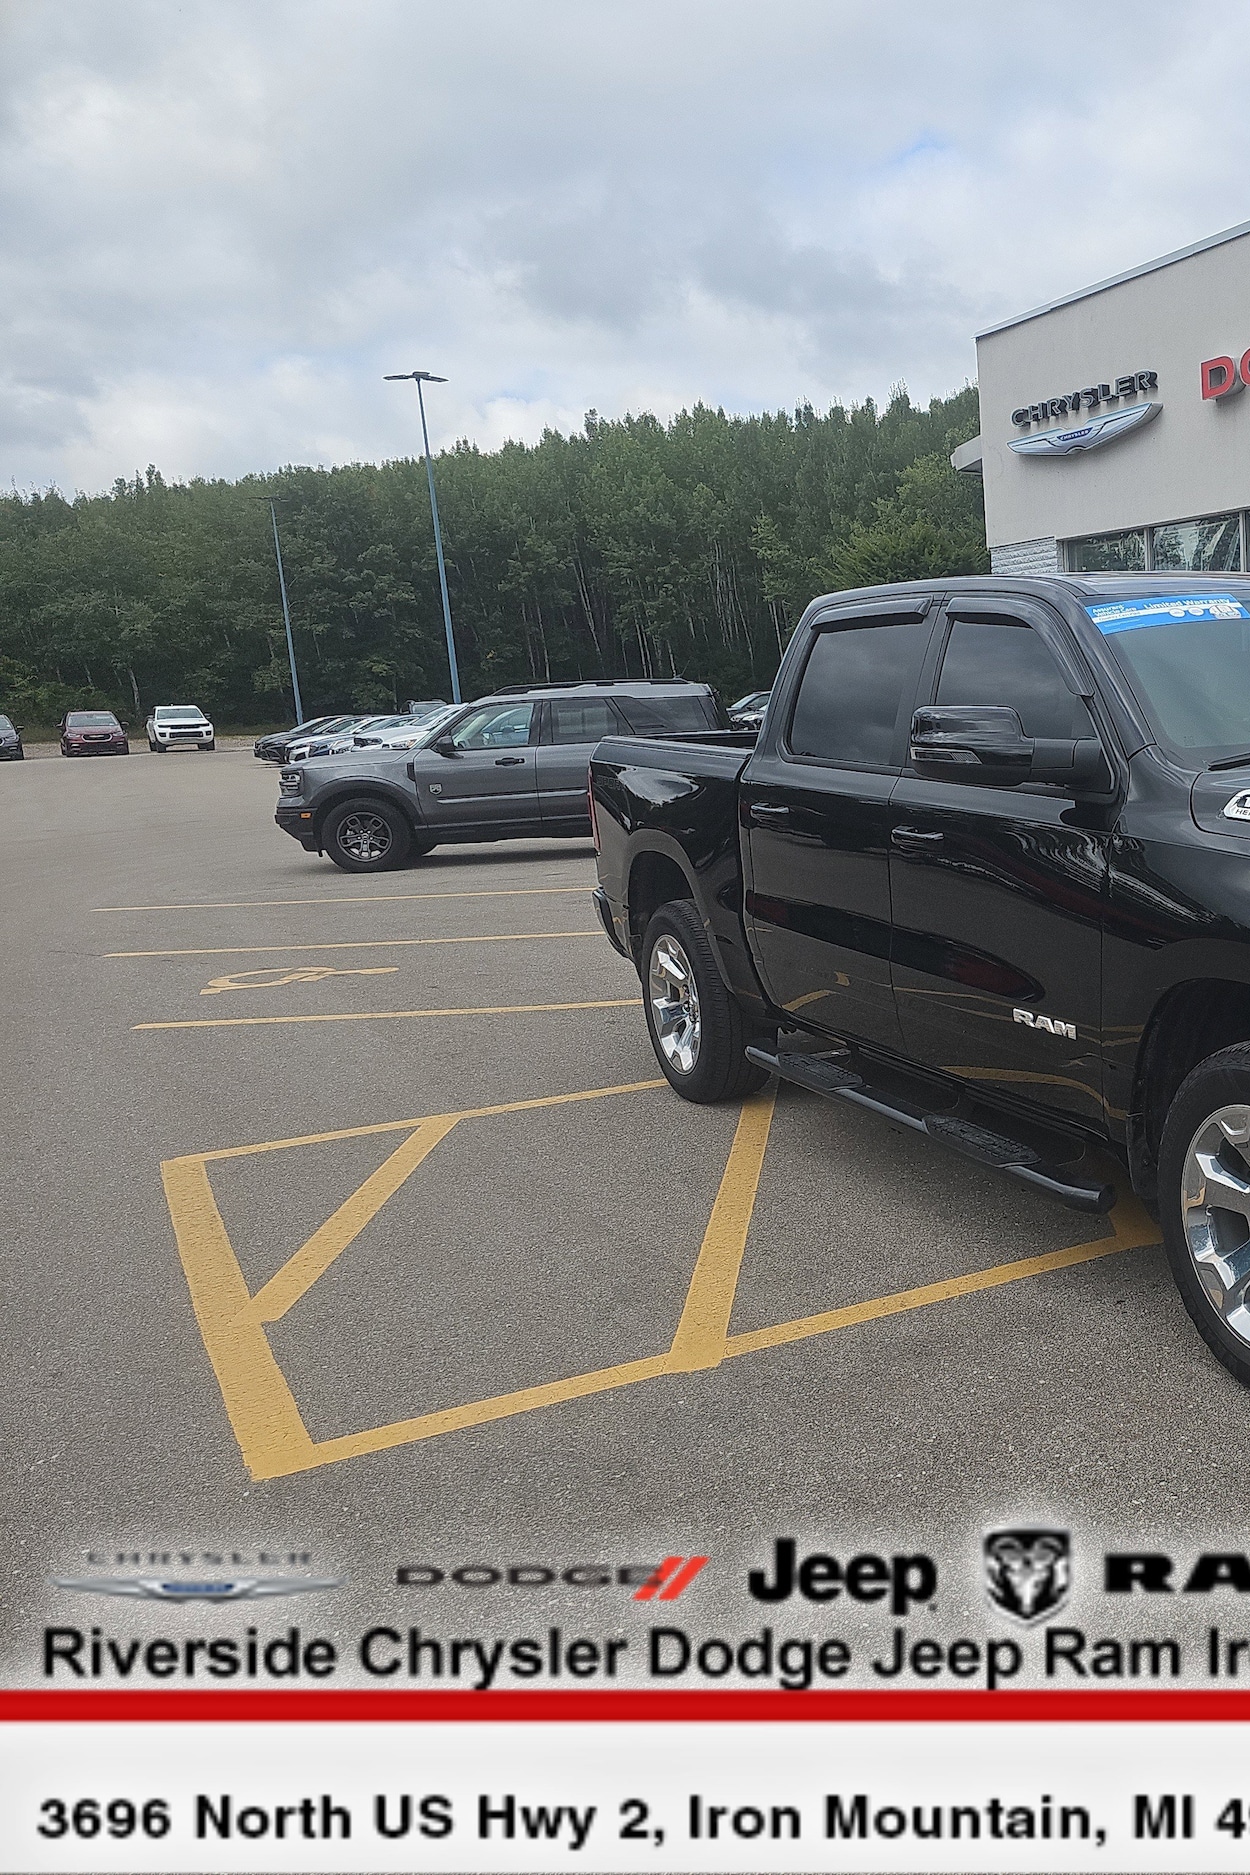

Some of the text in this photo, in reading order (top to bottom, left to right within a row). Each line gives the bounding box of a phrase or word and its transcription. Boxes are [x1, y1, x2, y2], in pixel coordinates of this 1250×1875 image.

[1011, 370, 1158, 427] CHRYSLER
[1143, 598, 1230, 609] Limited Warranty
[1012, 1007, 1077, 1041] RAM
